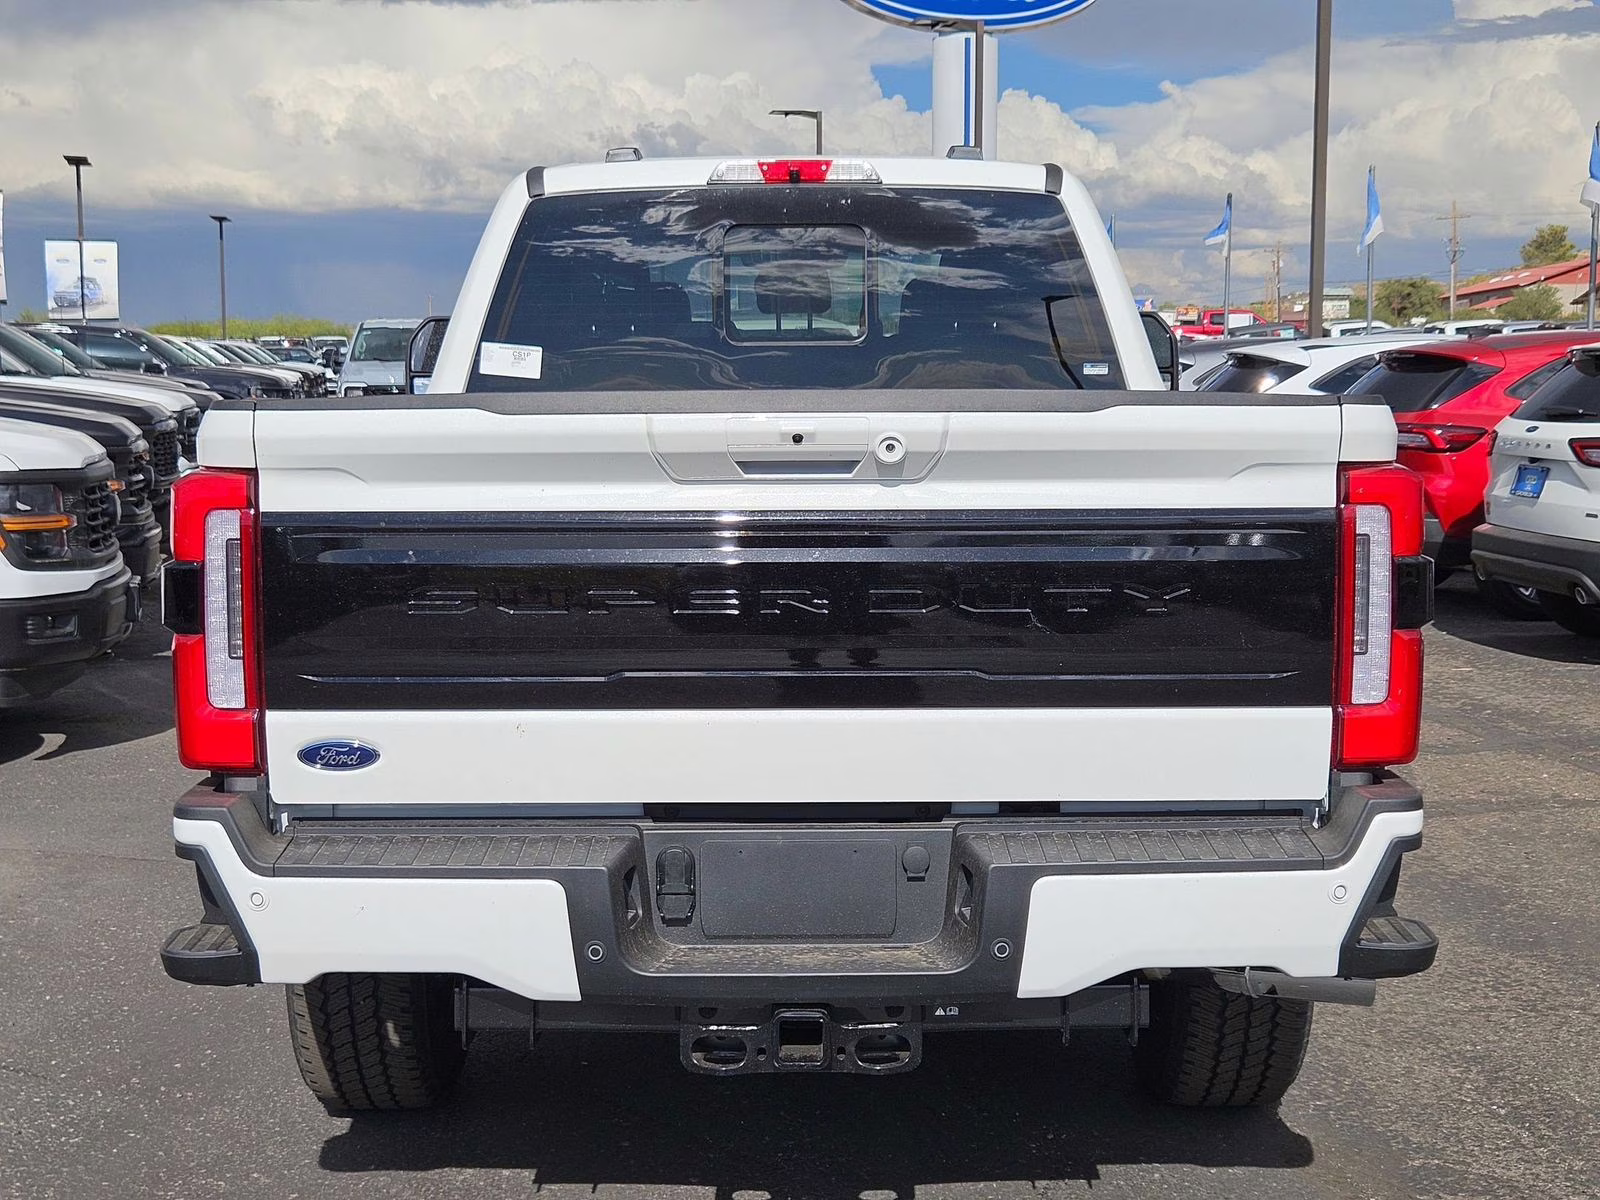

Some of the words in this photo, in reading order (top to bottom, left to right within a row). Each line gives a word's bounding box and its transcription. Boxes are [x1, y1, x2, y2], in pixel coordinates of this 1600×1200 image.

[408, 585, 830, 615] SUPER
[867, 583, 1193, 613] DUTY
[316, 746, 361, 765] Ford
